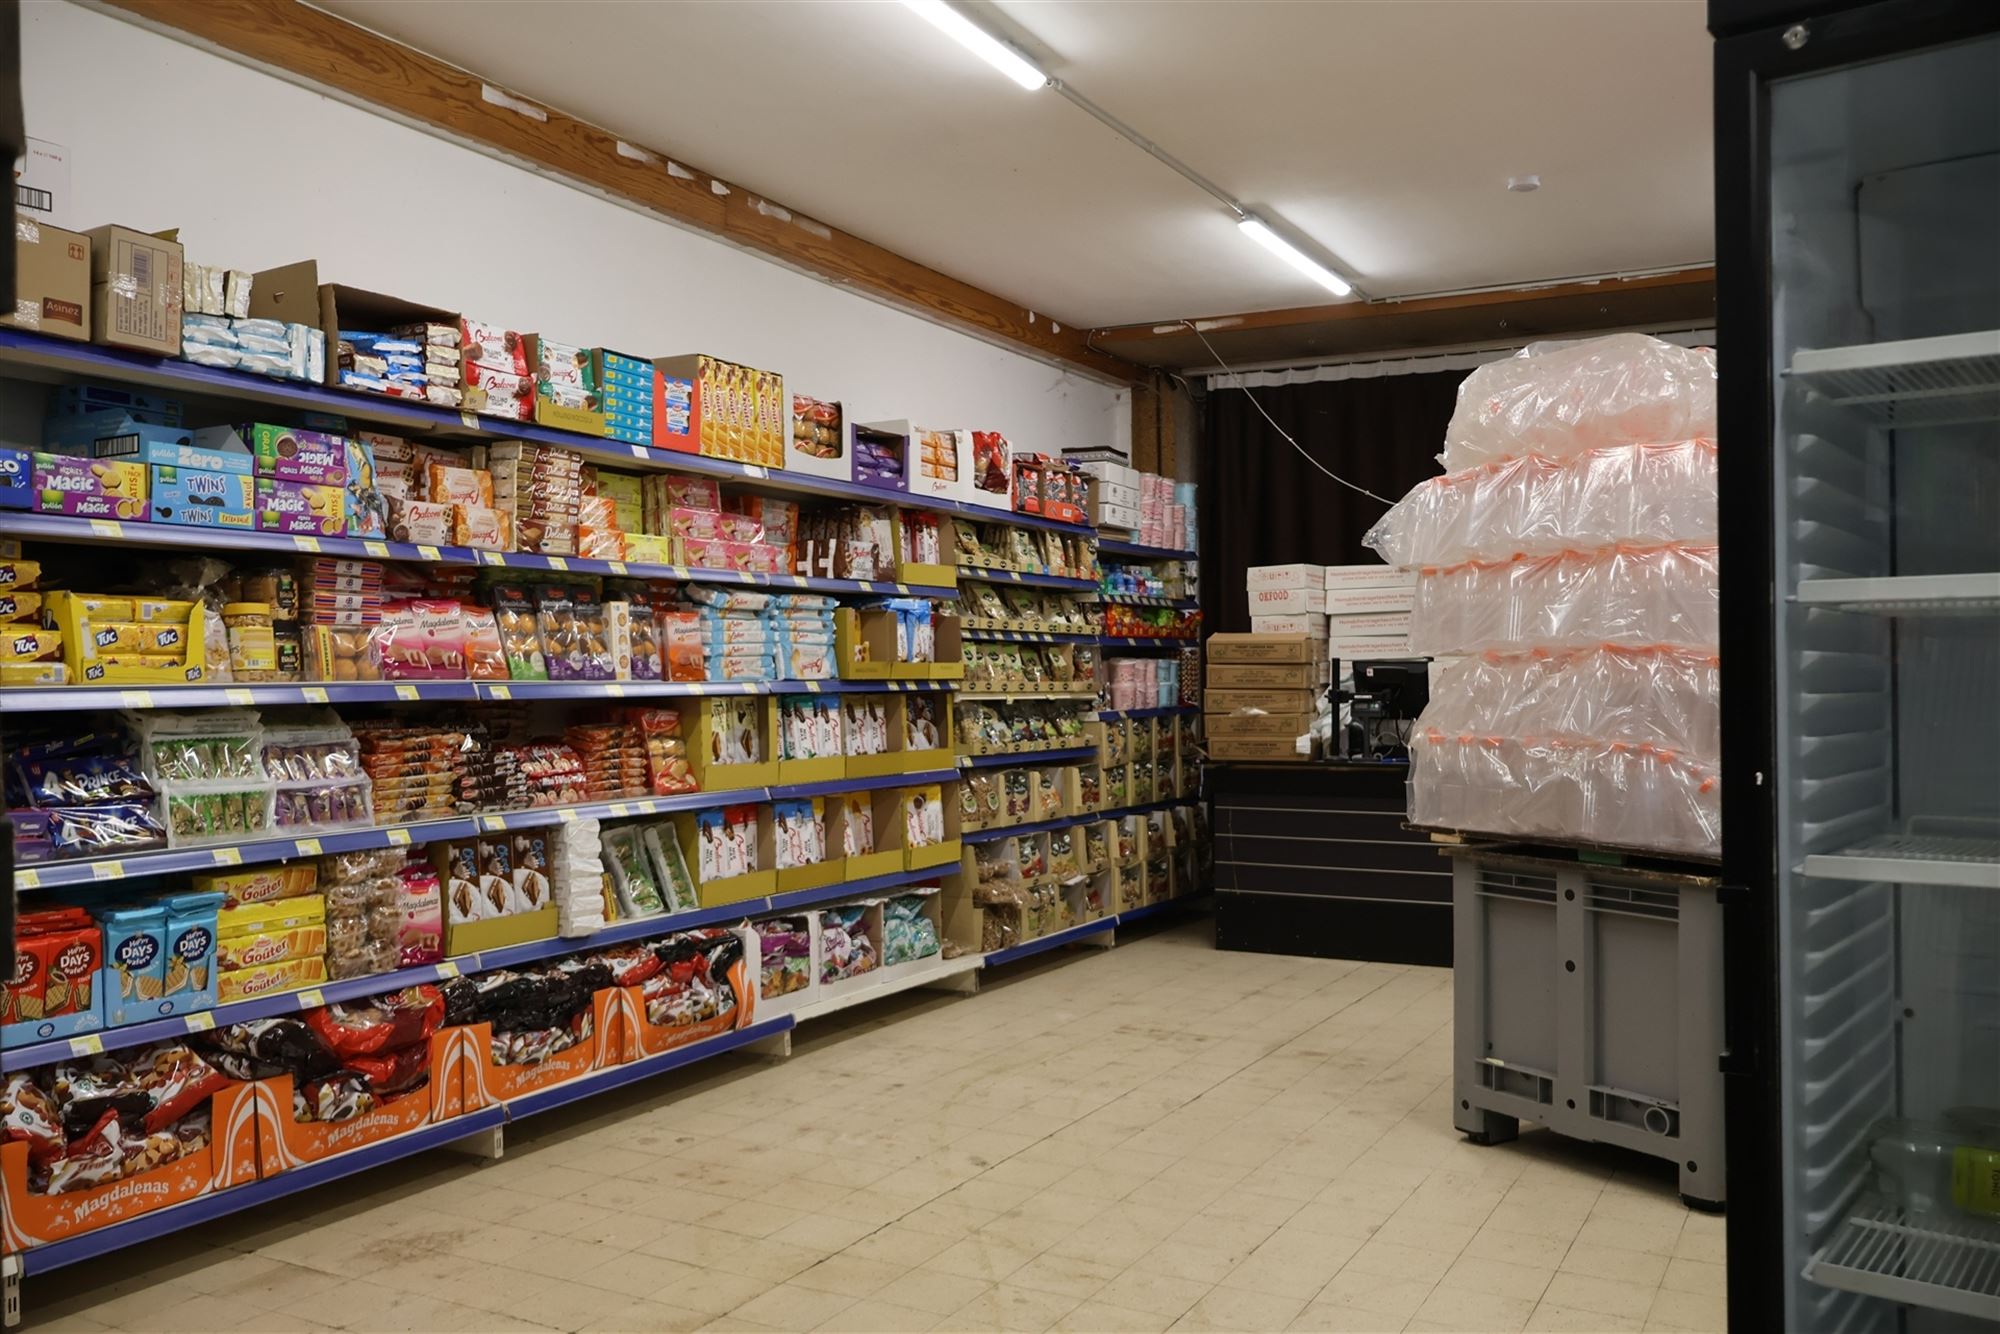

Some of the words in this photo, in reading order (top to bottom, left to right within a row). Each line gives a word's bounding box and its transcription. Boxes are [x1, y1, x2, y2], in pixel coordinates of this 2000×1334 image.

[45, 301, 80, 317] Asinez
[0, 569, 14, 583] UC
[0, 600, 14, 614] UC
[121, 943, 153, 960] DAYS
[179, 935, 207, 952] DAYS
[60, 951, 91, 968] DAYS
[18, 961, 34, 976] YS
[515, 1058, 570, 1089] Magdalenas
[326, 1112, 400, 1149] Magdalenas
[73, 1180, 170, 1225] Magdalenas
